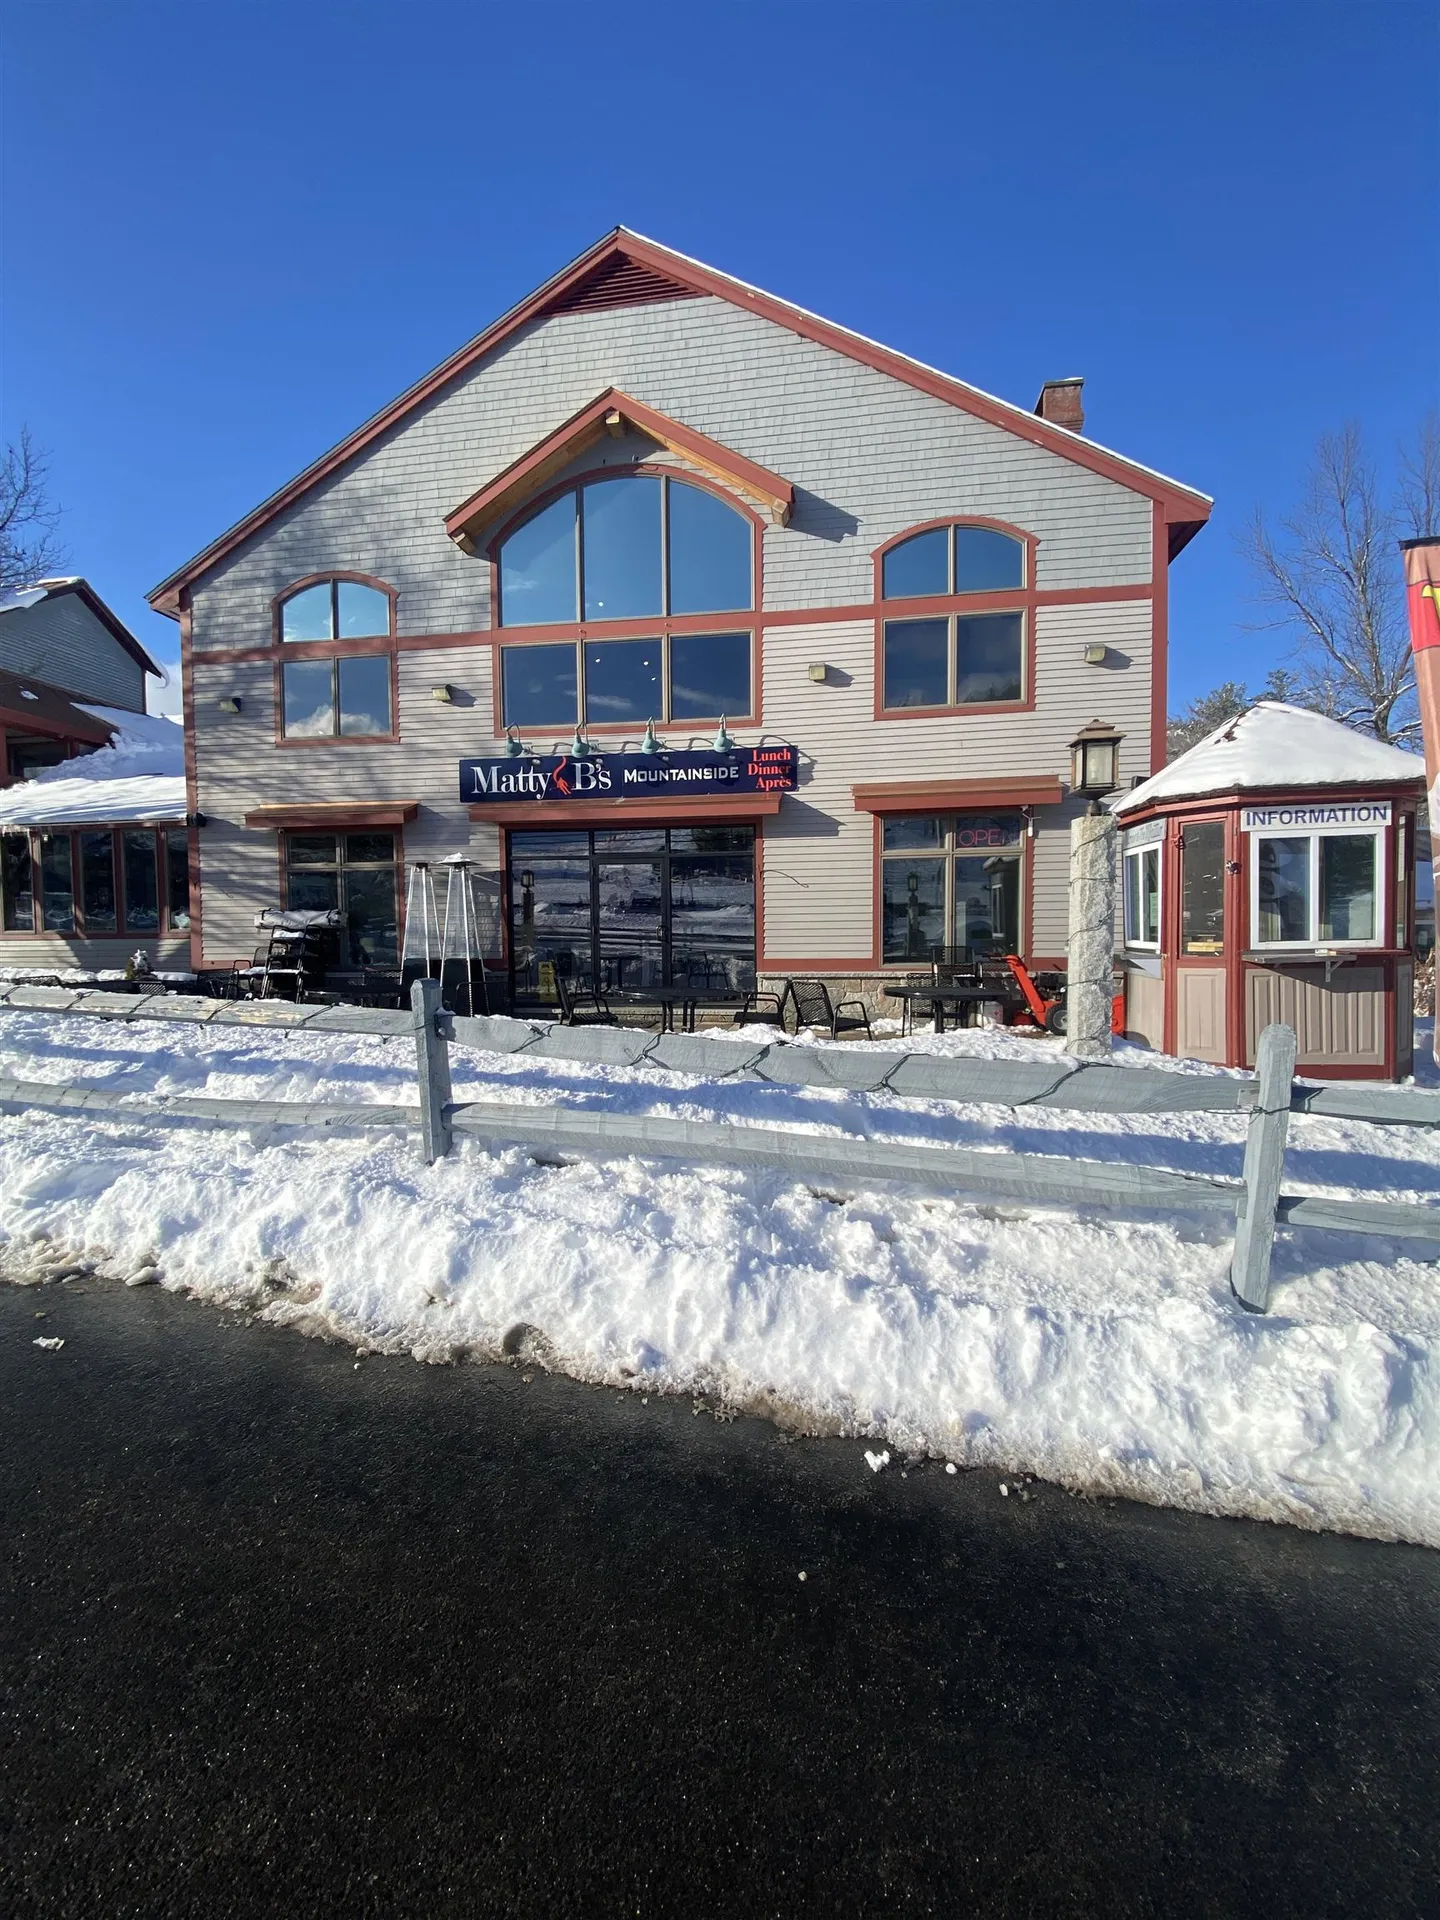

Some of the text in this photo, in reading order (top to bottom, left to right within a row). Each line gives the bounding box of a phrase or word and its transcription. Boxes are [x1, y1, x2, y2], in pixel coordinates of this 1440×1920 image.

[753, 748, 791, 762] Lunch
[748, 763, 791, 776] Dinner
[470, 762, 739, 799] Matty B's MOUNTAINSIDE
[756, 776, 791, 792] Après
[1246, 806, 1387, 826] INFORMATION
